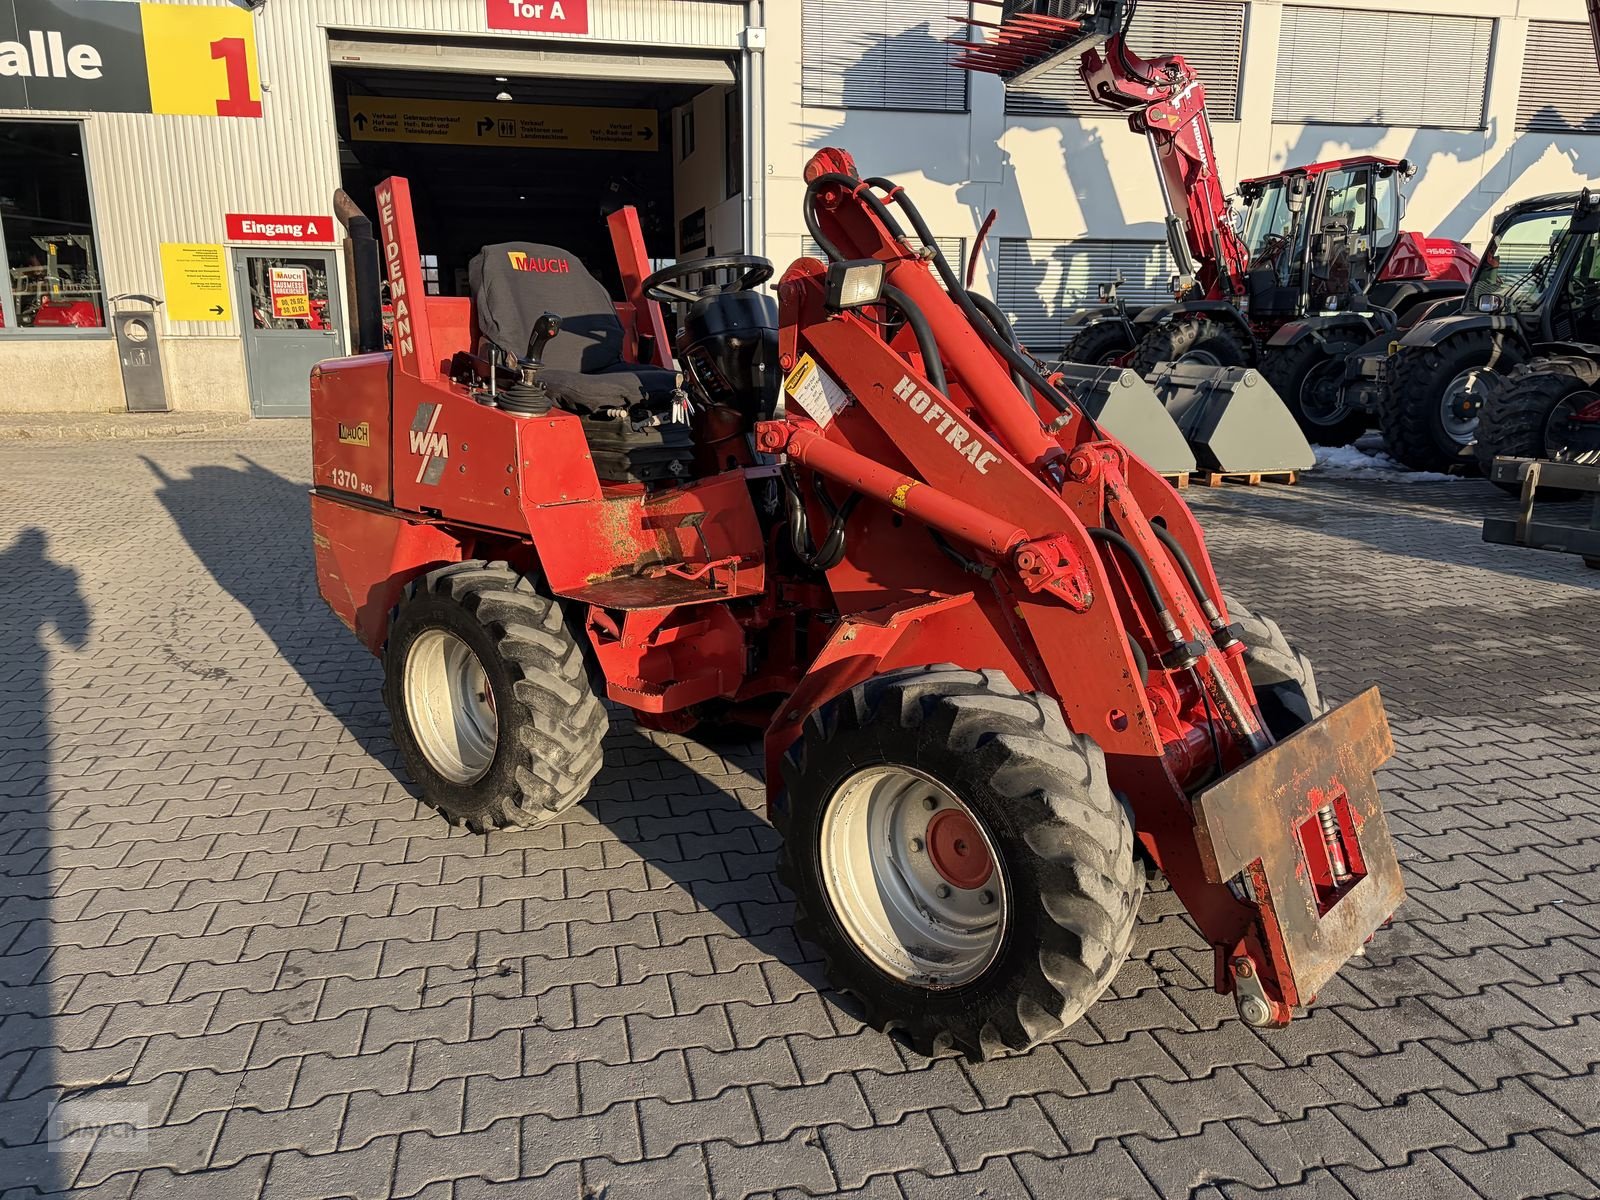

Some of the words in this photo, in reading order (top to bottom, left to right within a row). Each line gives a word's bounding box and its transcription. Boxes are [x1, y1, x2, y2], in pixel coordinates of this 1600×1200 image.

[509, 0, 543, 18] Tor
[550, 1, 566, 20] A
[0, 30, 103, 80] alle
[210, 37, 263, 118] 1
[372, 112, 397, 120] Verkauf
[403, 114, 461, 122] Gebrauchtverkauf
[520, 119, 545, 127] Verkauf
[767, 164, 774, 175] 3
[241, 220, 303, 237] Eingang
[306, 222, 319, 235] A
[378, 189, 414, 358] WEIDEMANN
[515, 256, 570, 273] MAUCH
[338, 422, 369, 442] MAUCH
[893, 374, 998, 475] HOFTRAC
[331, 467, 358, 490] 1370
[360, 482, 373, 494] P43
